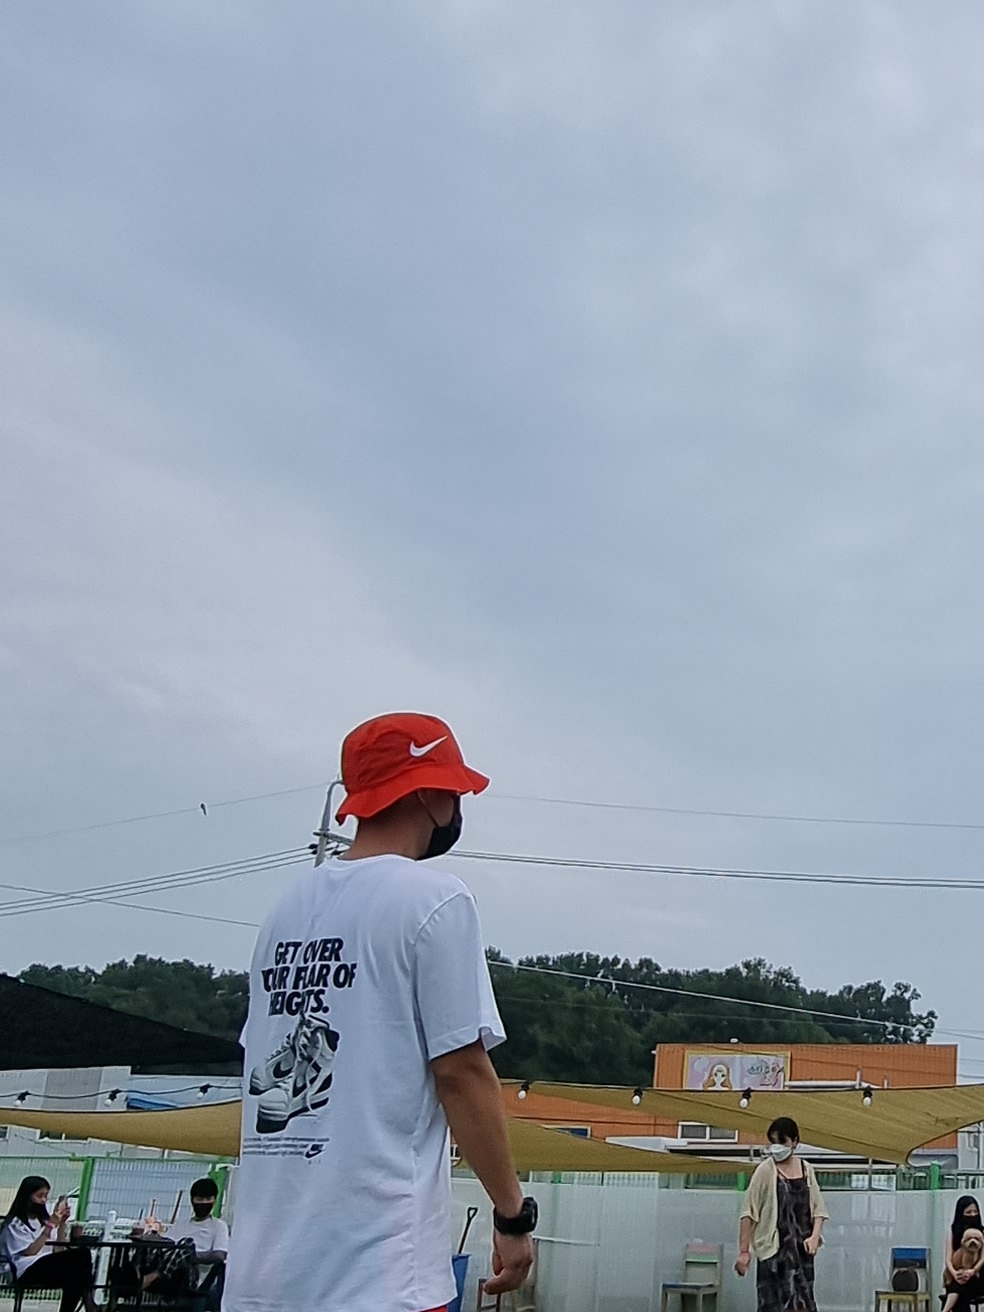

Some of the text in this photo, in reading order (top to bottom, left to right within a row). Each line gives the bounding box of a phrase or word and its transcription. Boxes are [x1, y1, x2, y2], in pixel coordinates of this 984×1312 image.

[275, 938, 344, 966] GET OVER
[333, 963, 357, 989] OF
